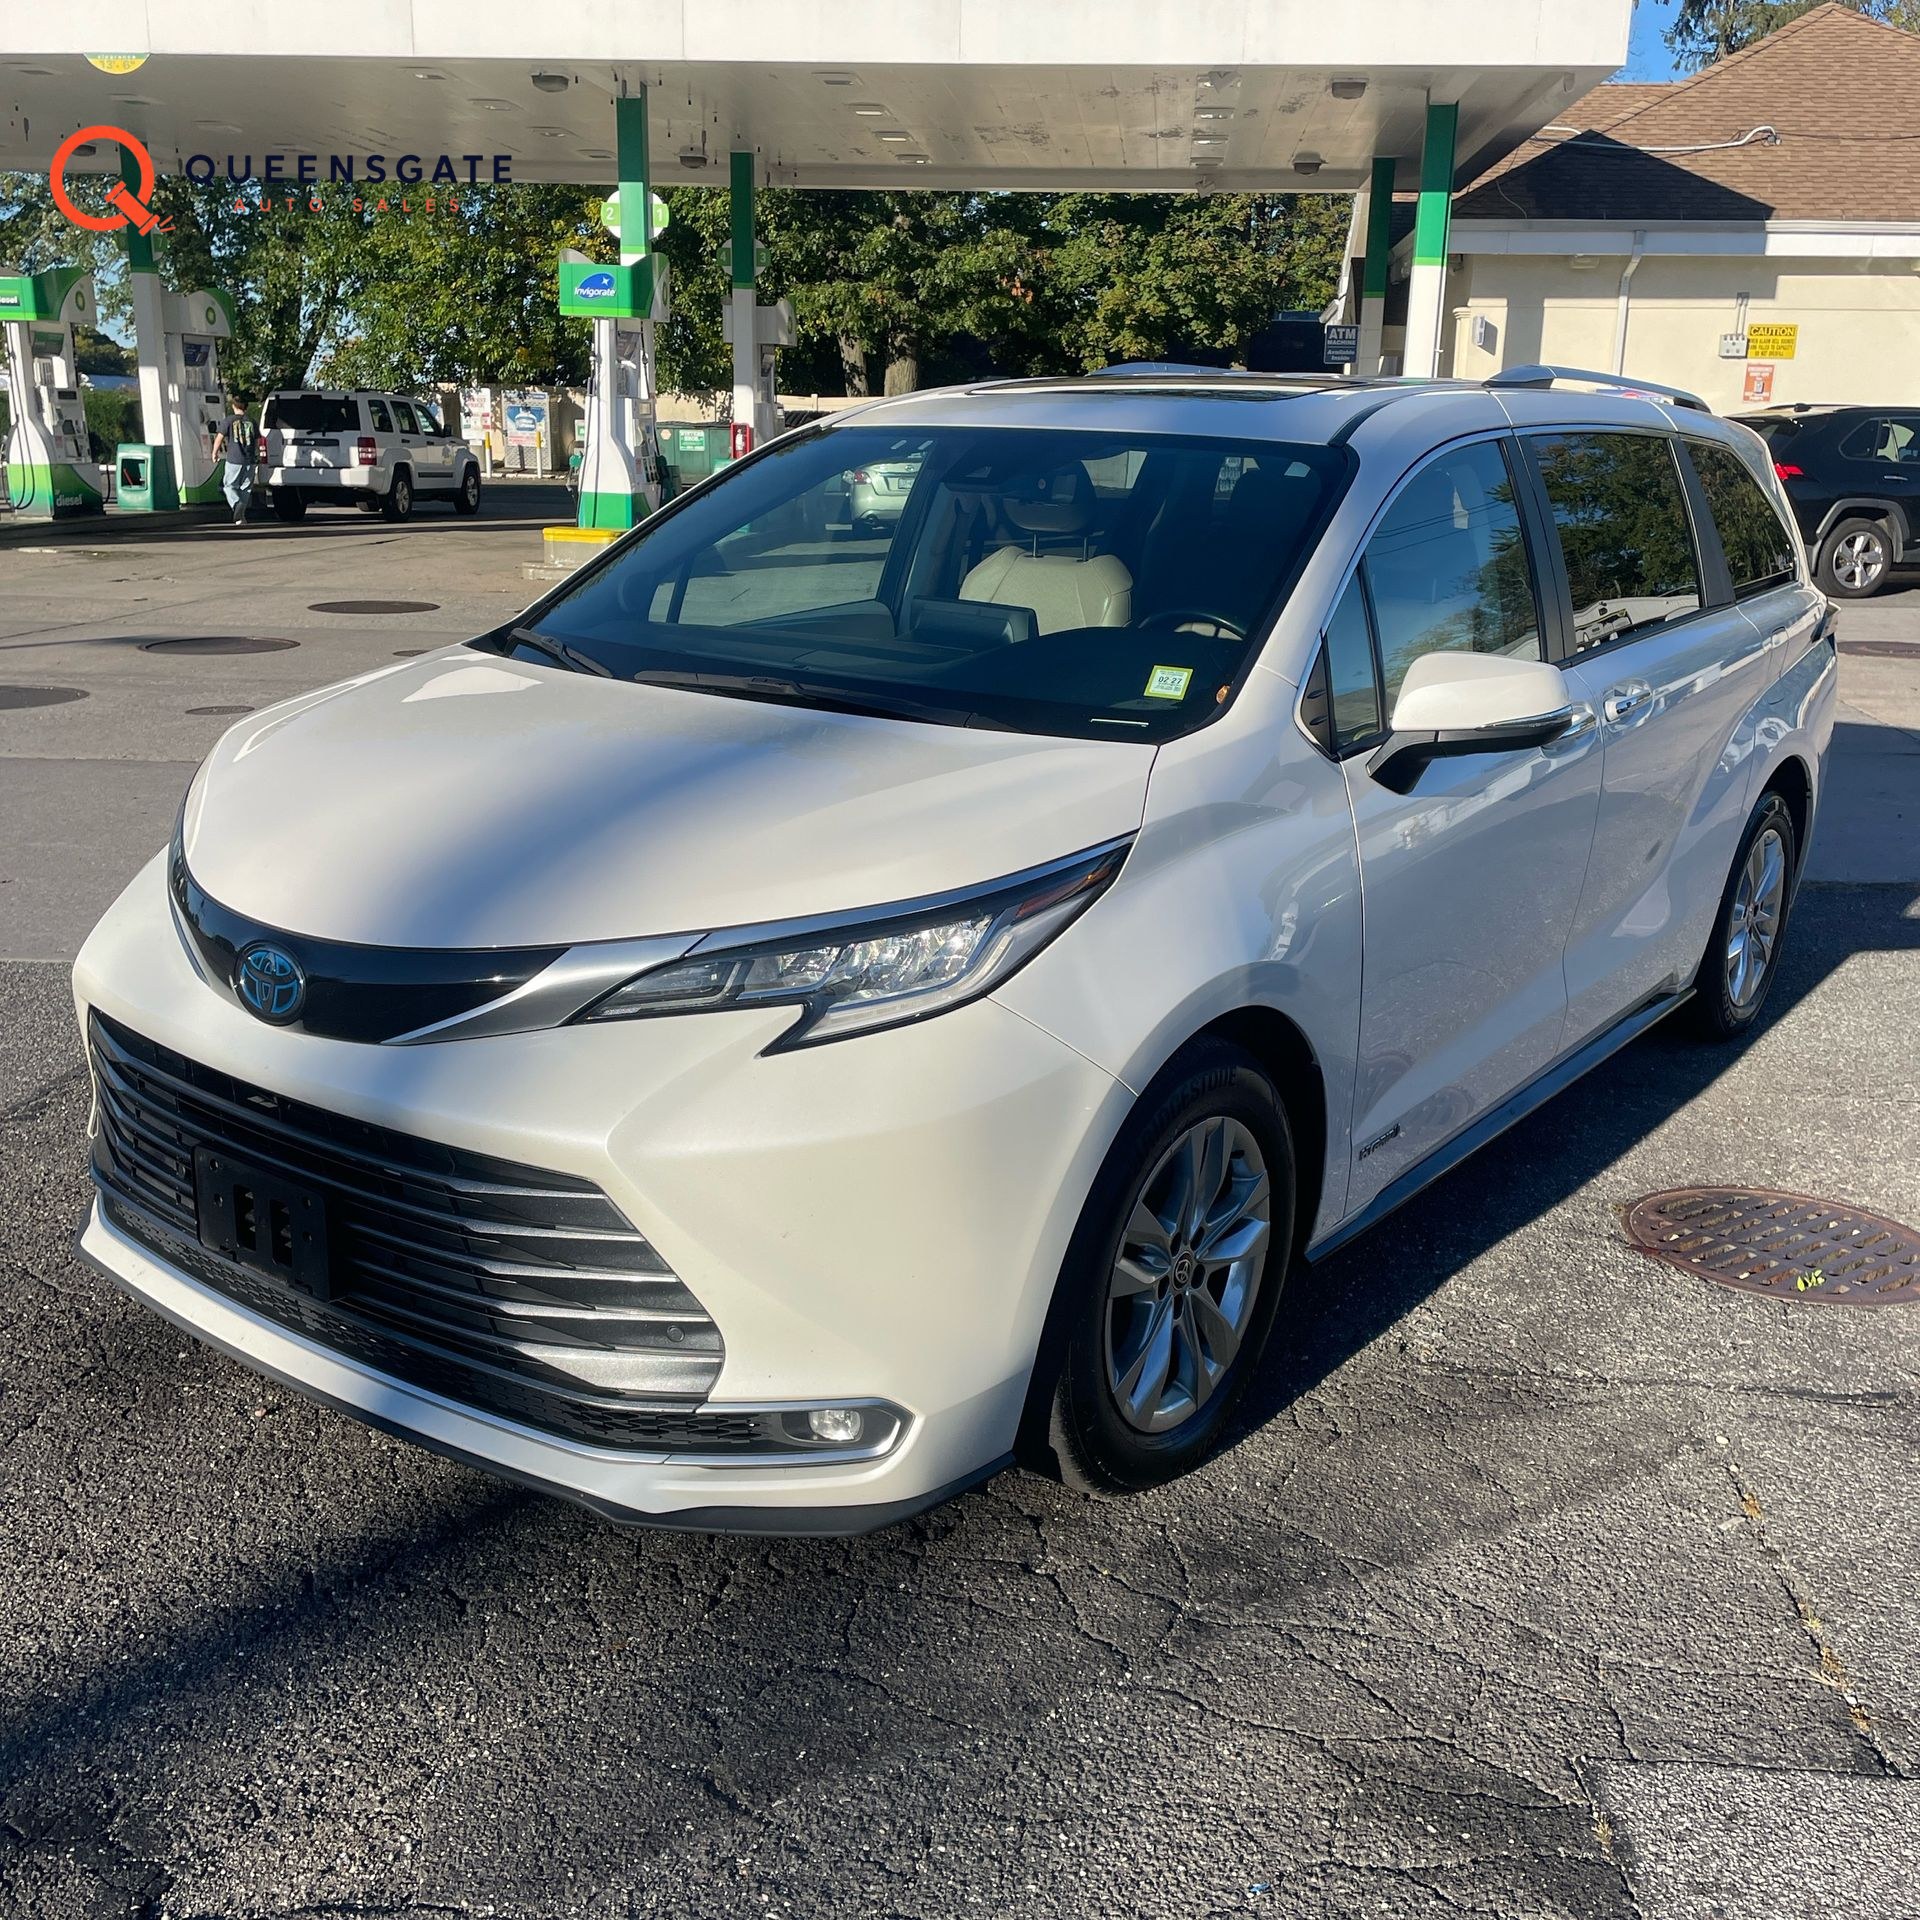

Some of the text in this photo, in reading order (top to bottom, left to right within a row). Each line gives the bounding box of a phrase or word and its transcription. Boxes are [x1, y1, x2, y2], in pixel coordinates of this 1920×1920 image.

[606, 207, 615, 220] 2
[656, 208, 663, 220] 1
[720, 251, 726, 262] 4
[759, 252, 766, 263] 3
[574, 287, 616, 298] Invigorate
[1329, 328, 1356, 339] ATM
[1751, 327, 1794, 336] CAUTION
[56, 494, 82, 507] diesel
